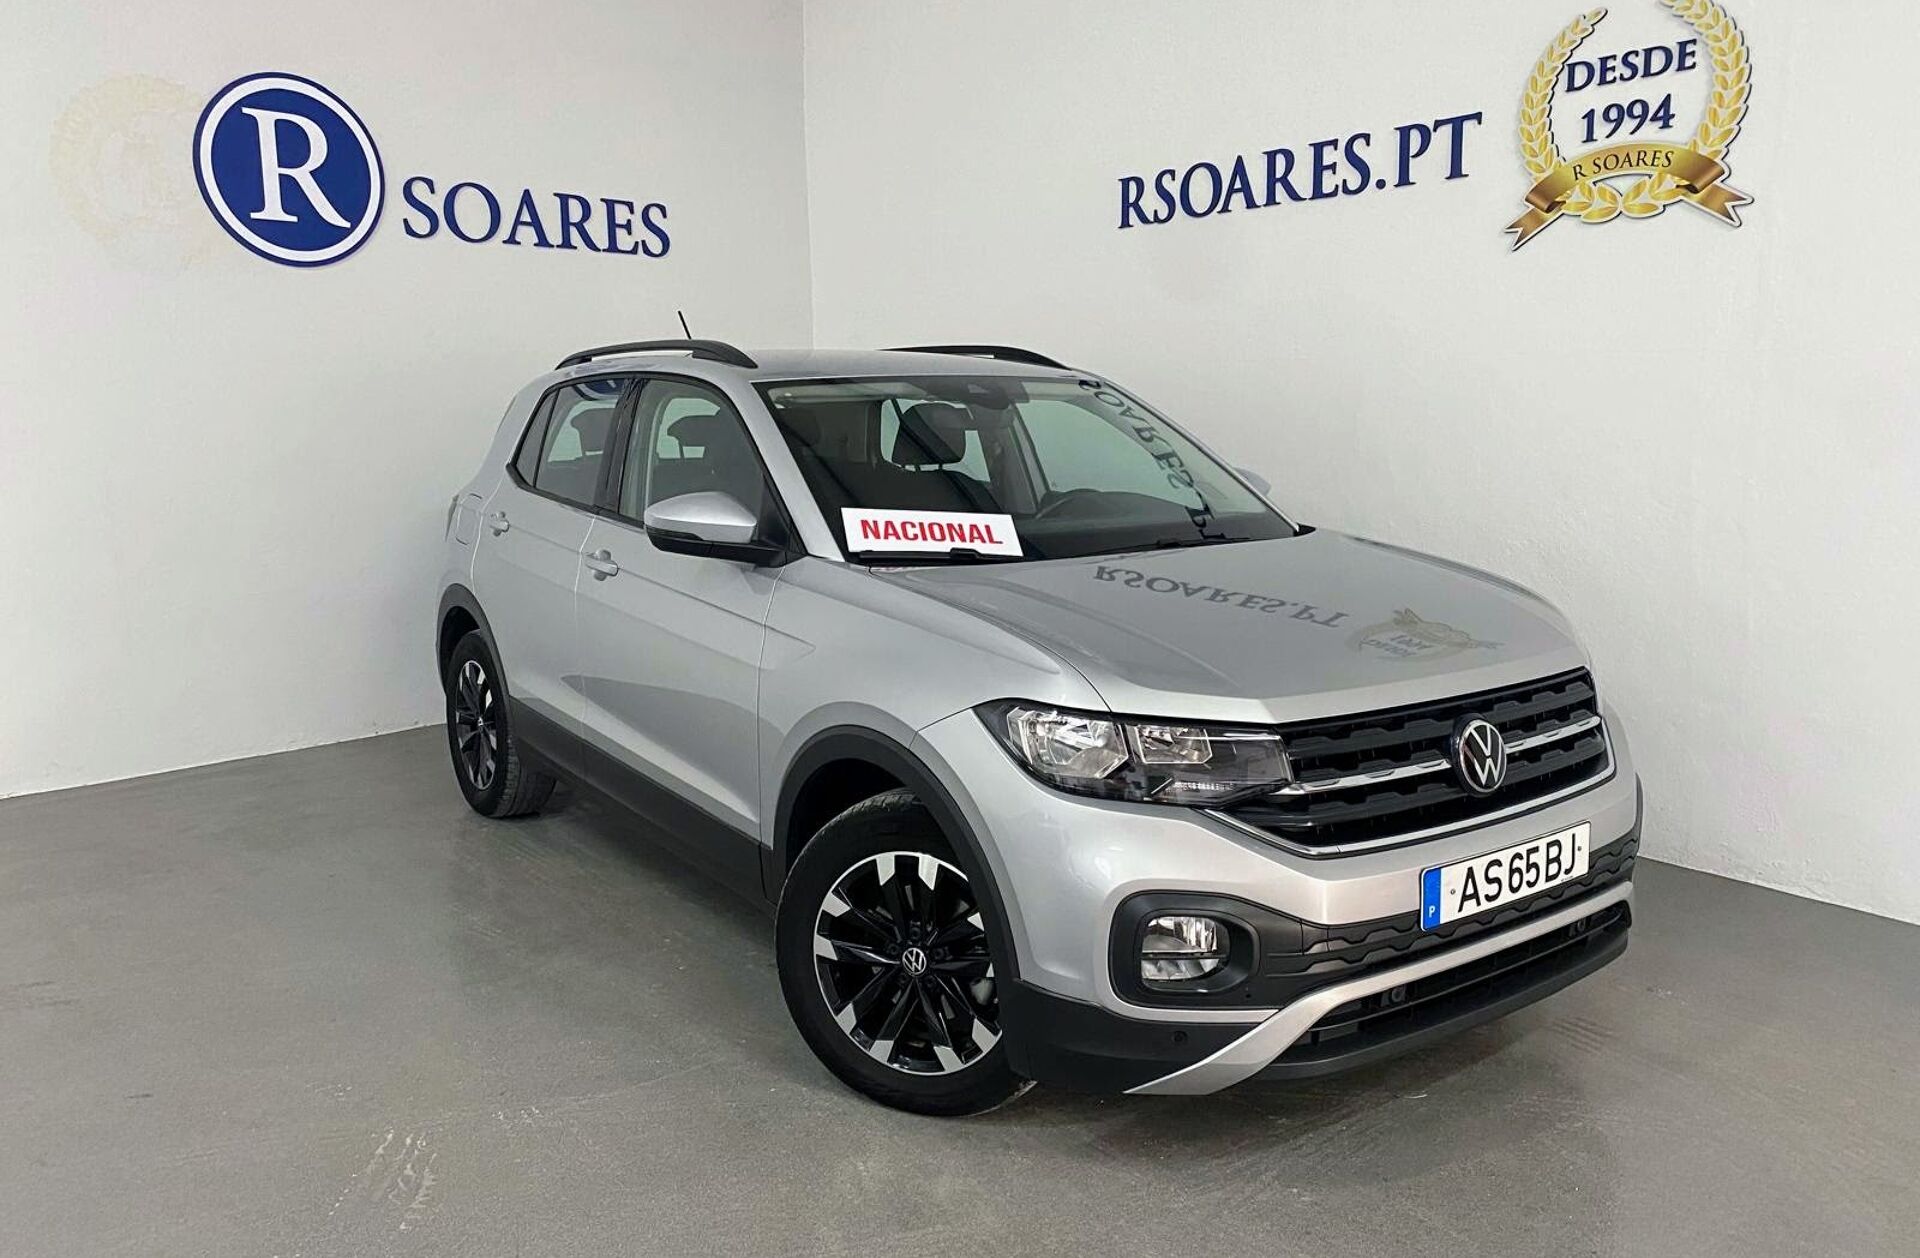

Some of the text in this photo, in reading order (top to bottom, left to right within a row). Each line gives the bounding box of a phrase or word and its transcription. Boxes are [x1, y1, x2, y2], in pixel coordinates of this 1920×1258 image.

[1564, 38, 1698, 93] DESDE
[1580, 93, 1676, 144] 1994
[241, 106, 671, 258] R SOARES
[1117, 111, 1483, 229] RSOARES.PT
[1572, 150, 1674, 182] R SOARES
[860, 518, 1004, 545] NACIONAL
[1428, 905, 1436, 918] P
